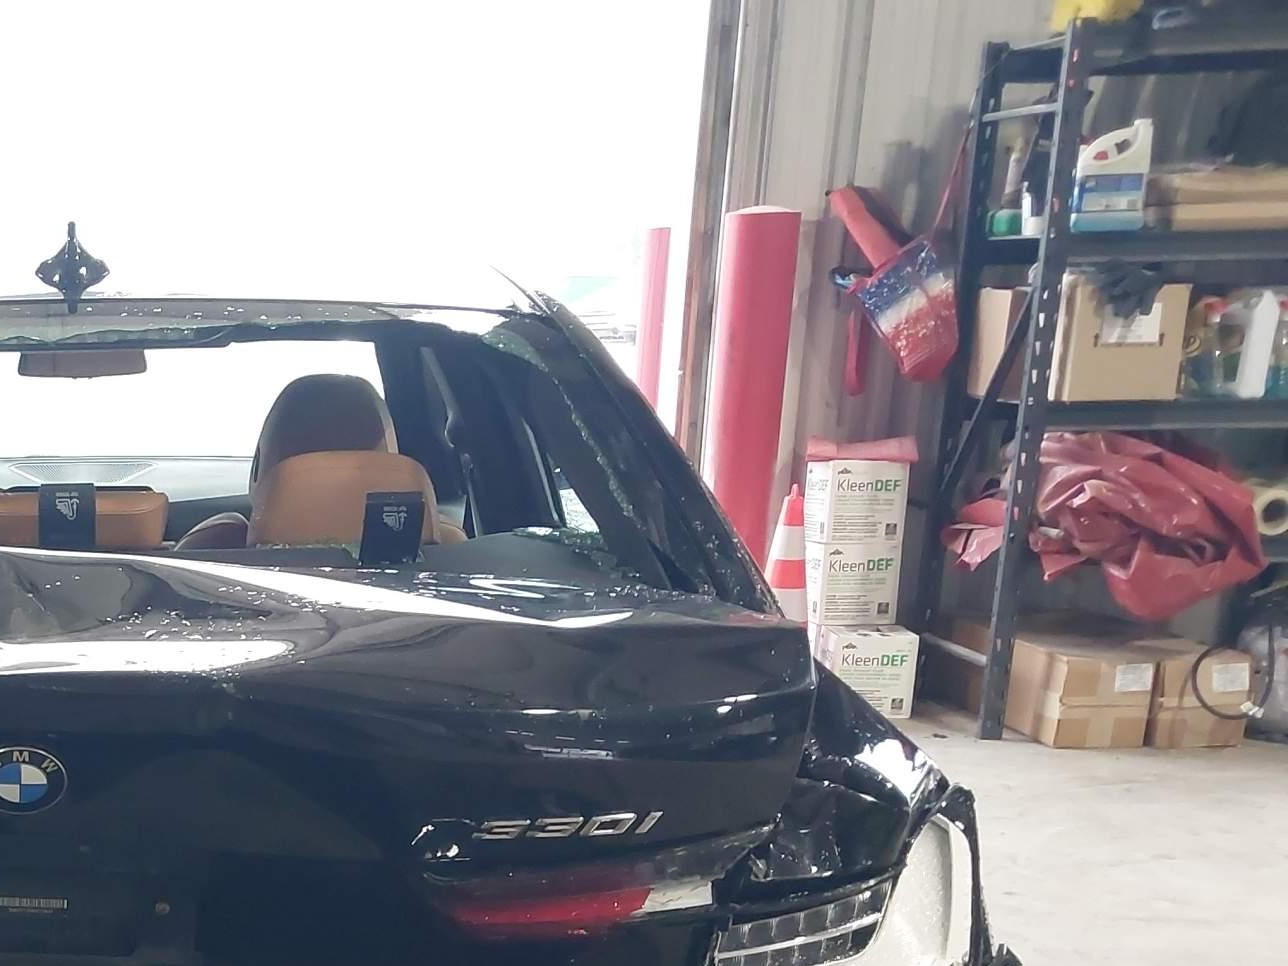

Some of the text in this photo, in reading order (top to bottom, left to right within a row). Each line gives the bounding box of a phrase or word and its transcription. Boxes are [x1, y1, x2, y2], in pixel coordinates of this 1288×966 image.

[837, 479, 902, 492] KleenDEF
[829, 557, 893, 572] KleenDEF
[841, 653, 909, 666] KleenDEF
